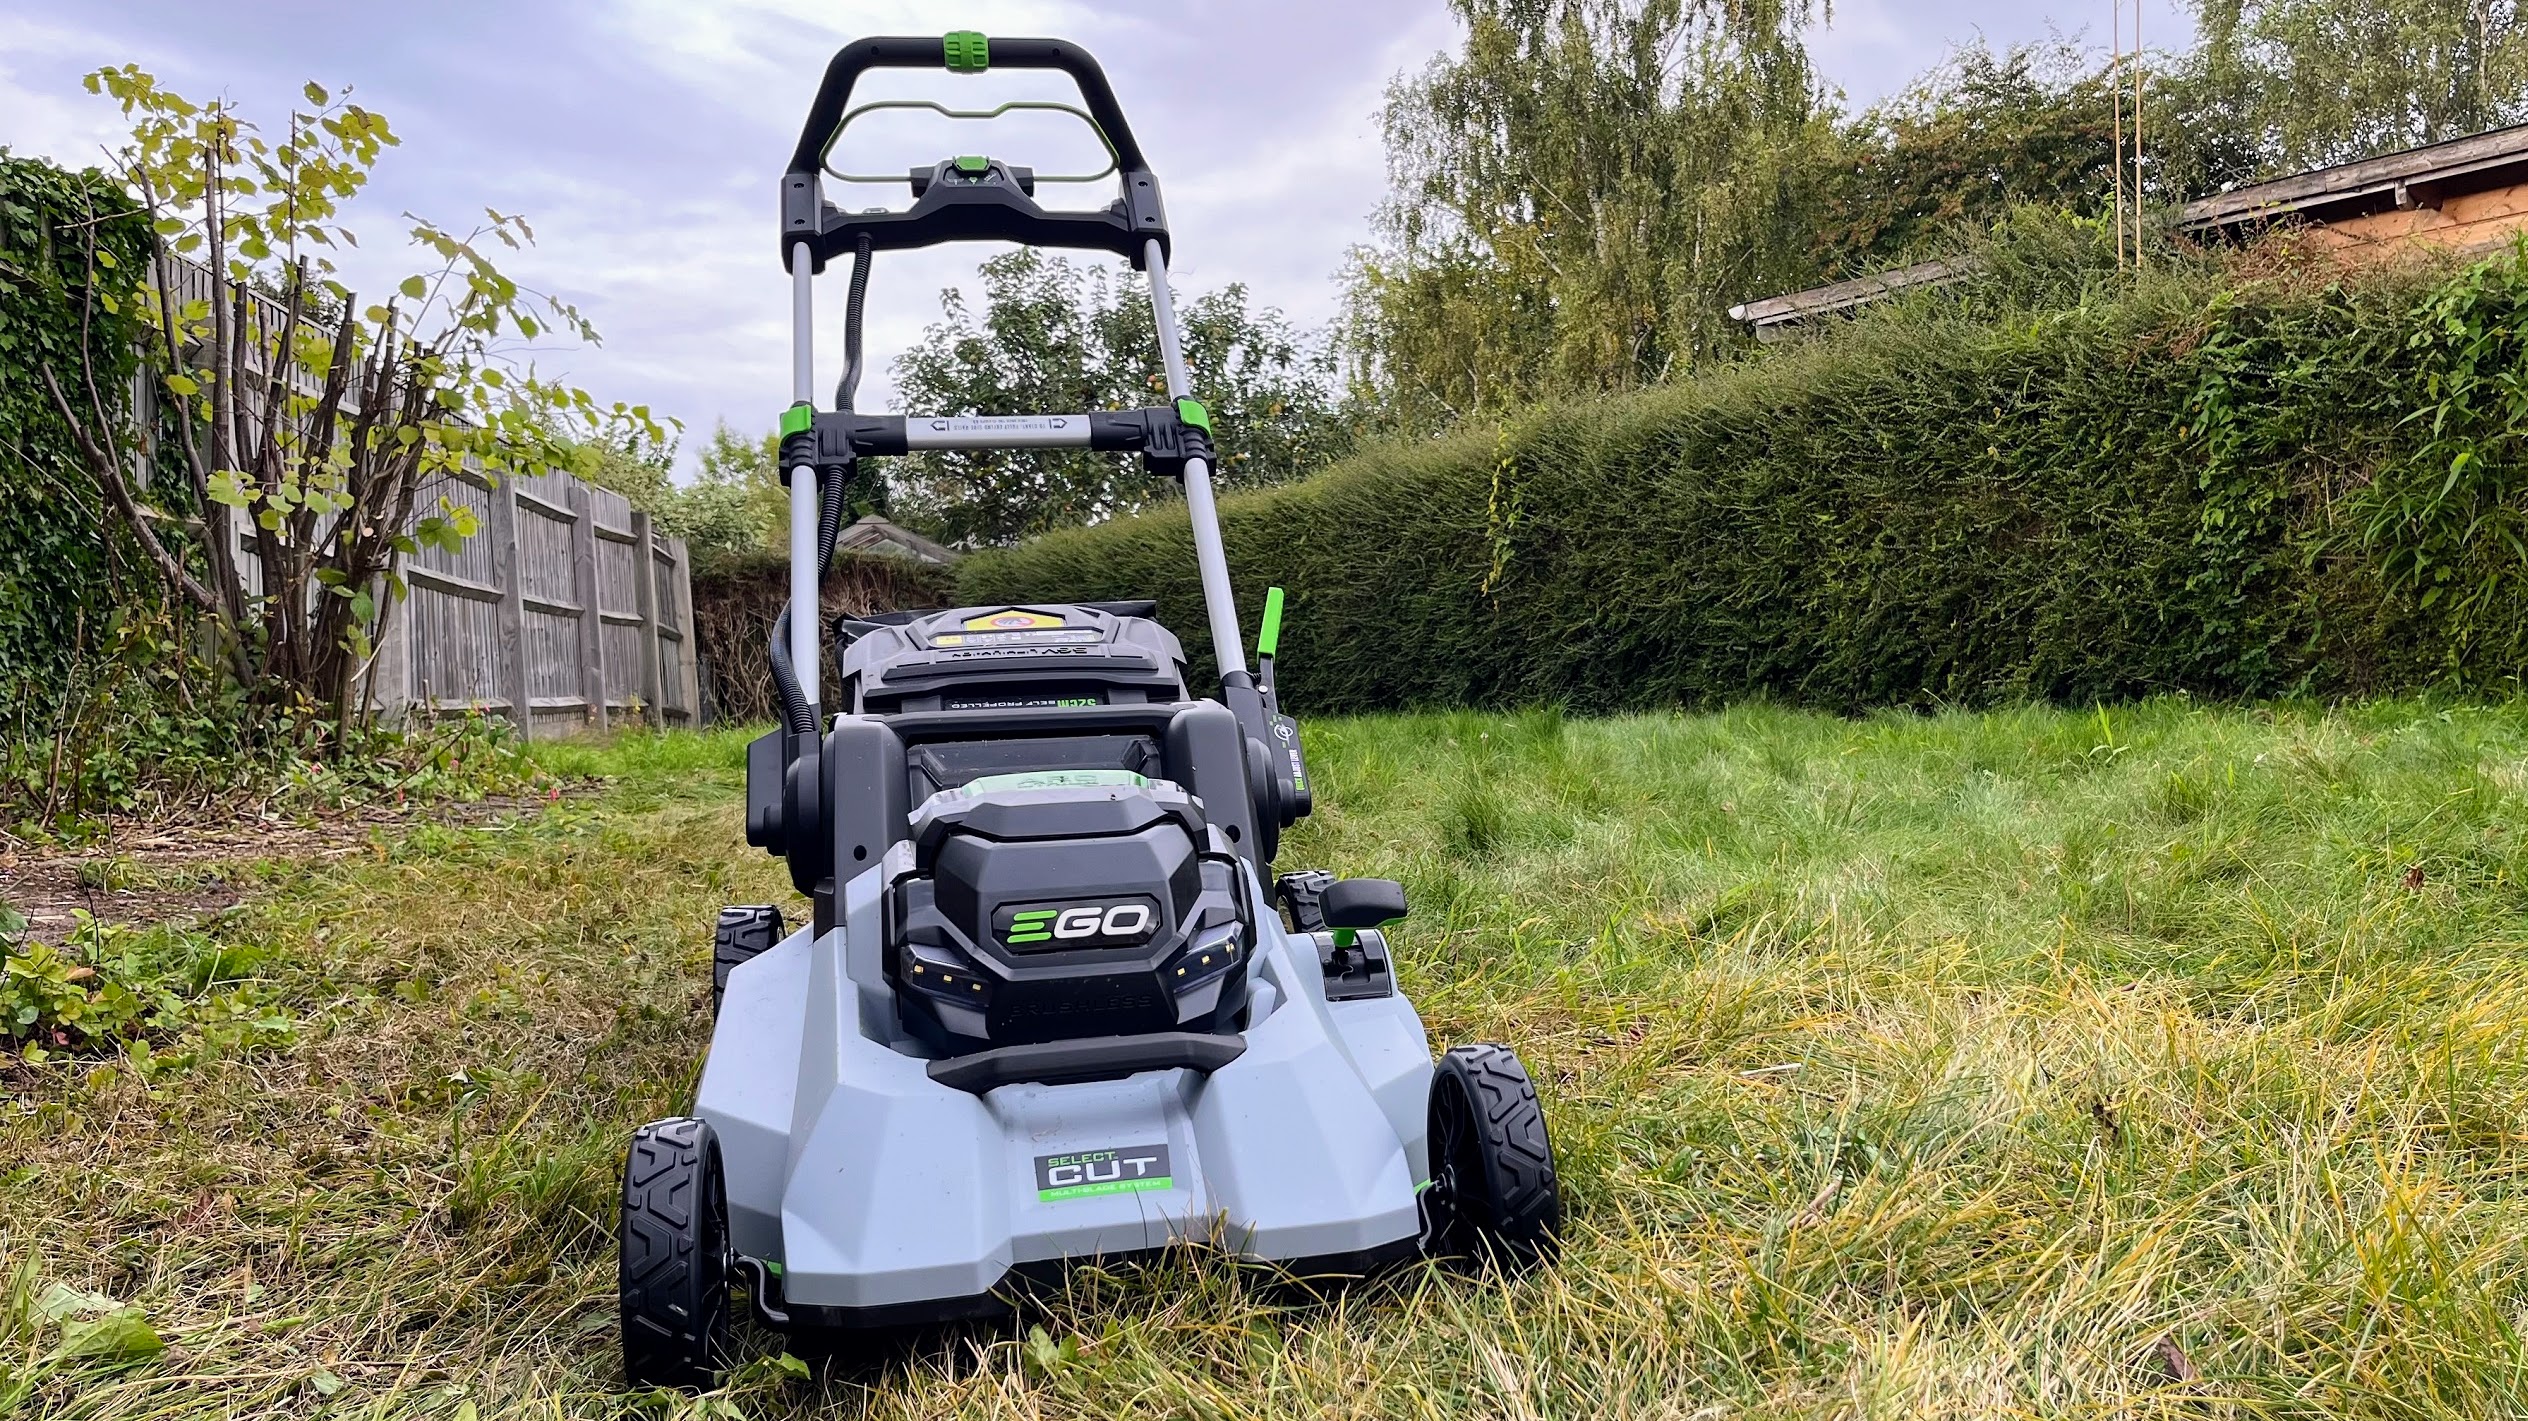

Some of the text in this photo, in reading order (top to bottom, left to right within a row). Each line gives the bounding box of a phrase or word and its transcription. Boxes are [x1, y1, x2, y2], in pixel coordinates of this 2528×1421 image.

[951, 700, 1023, 709] PROPELLED
[1006, 905, 1150, 944] EGO
[1048, 1151, 1117, 1167] SELECT
[1048, 1157, 1157, 1186] CUT
